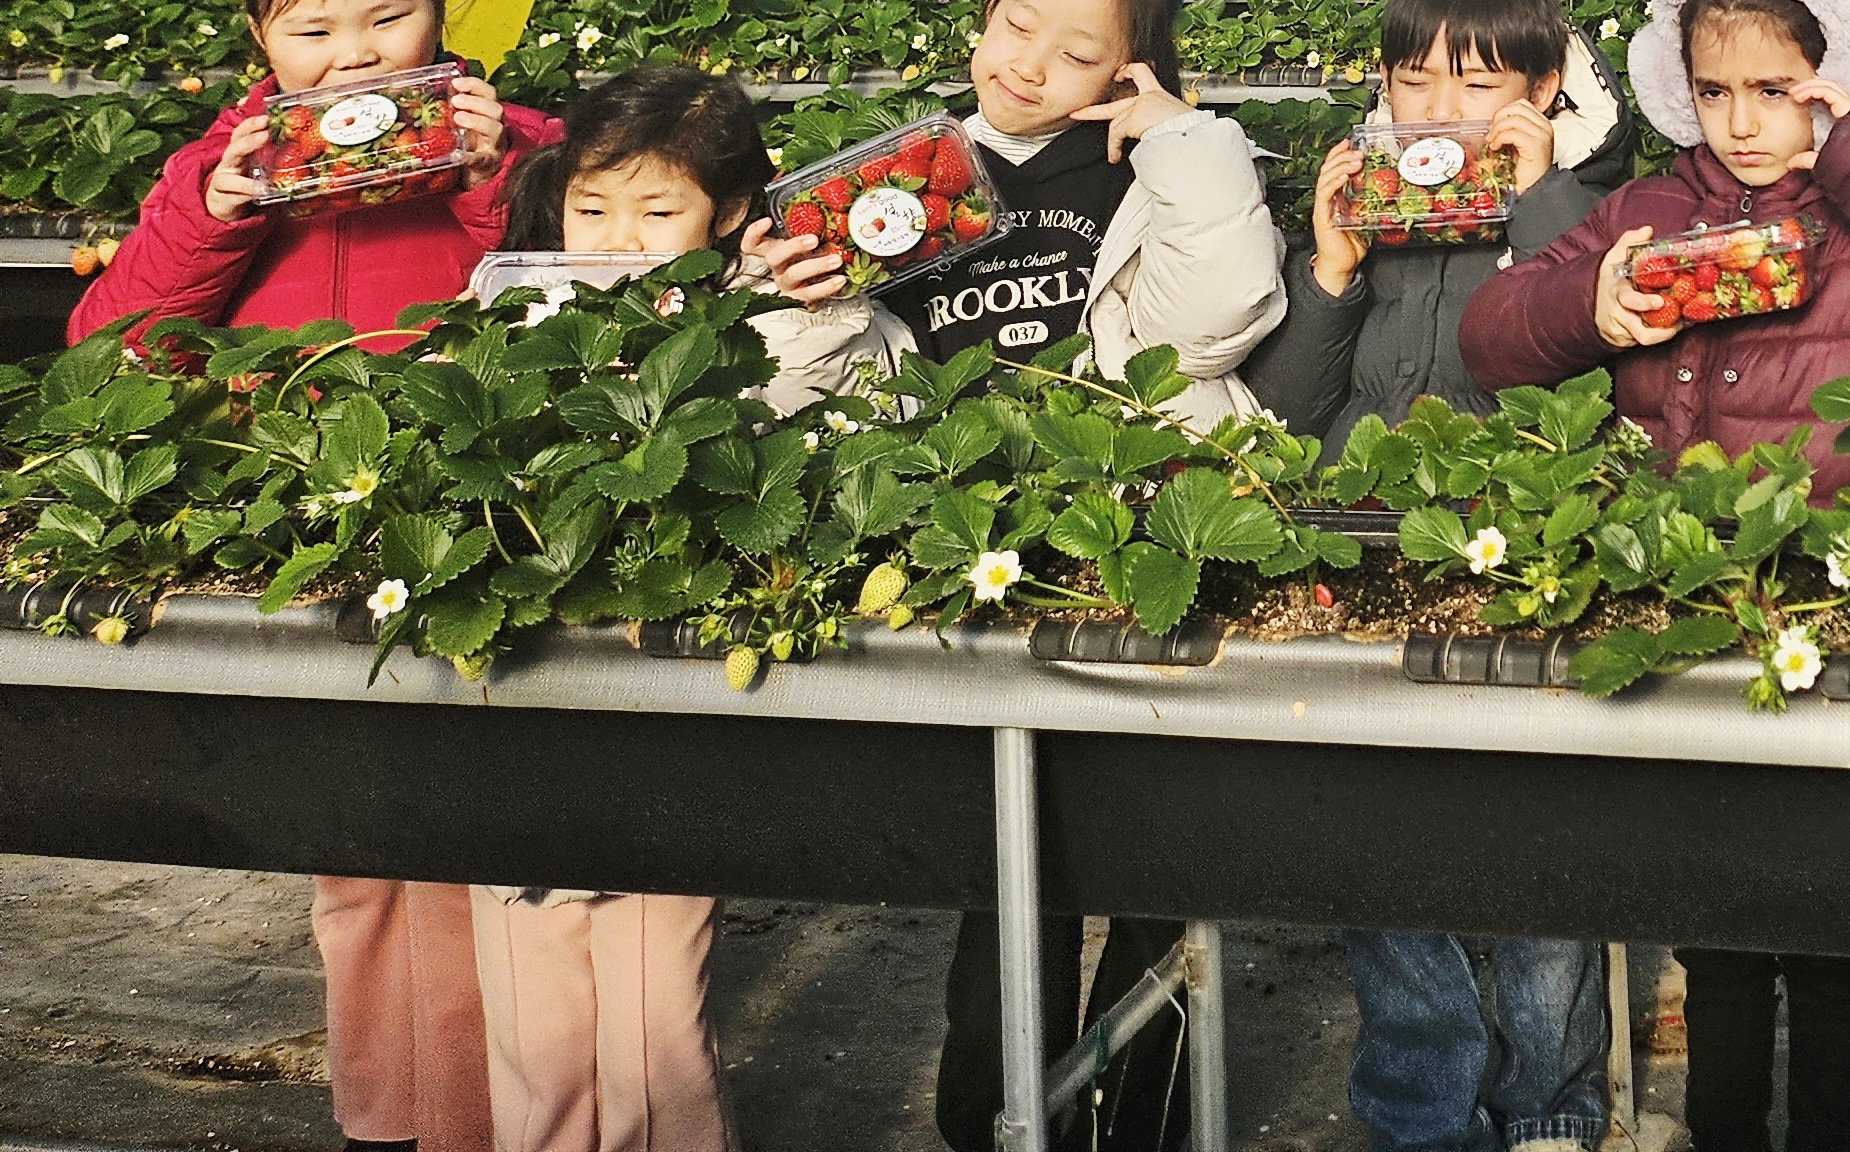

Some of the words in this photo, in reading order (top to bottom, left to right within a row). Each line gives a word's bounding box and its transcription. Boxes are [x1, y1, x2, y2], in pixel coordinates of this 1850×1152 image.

[968, 255, 1007, 278] Make
[1008, 258, 1020, 269] a
[923, 266, 1093, 332] ROOKL
[1008, 325, 1038, 343] 037
